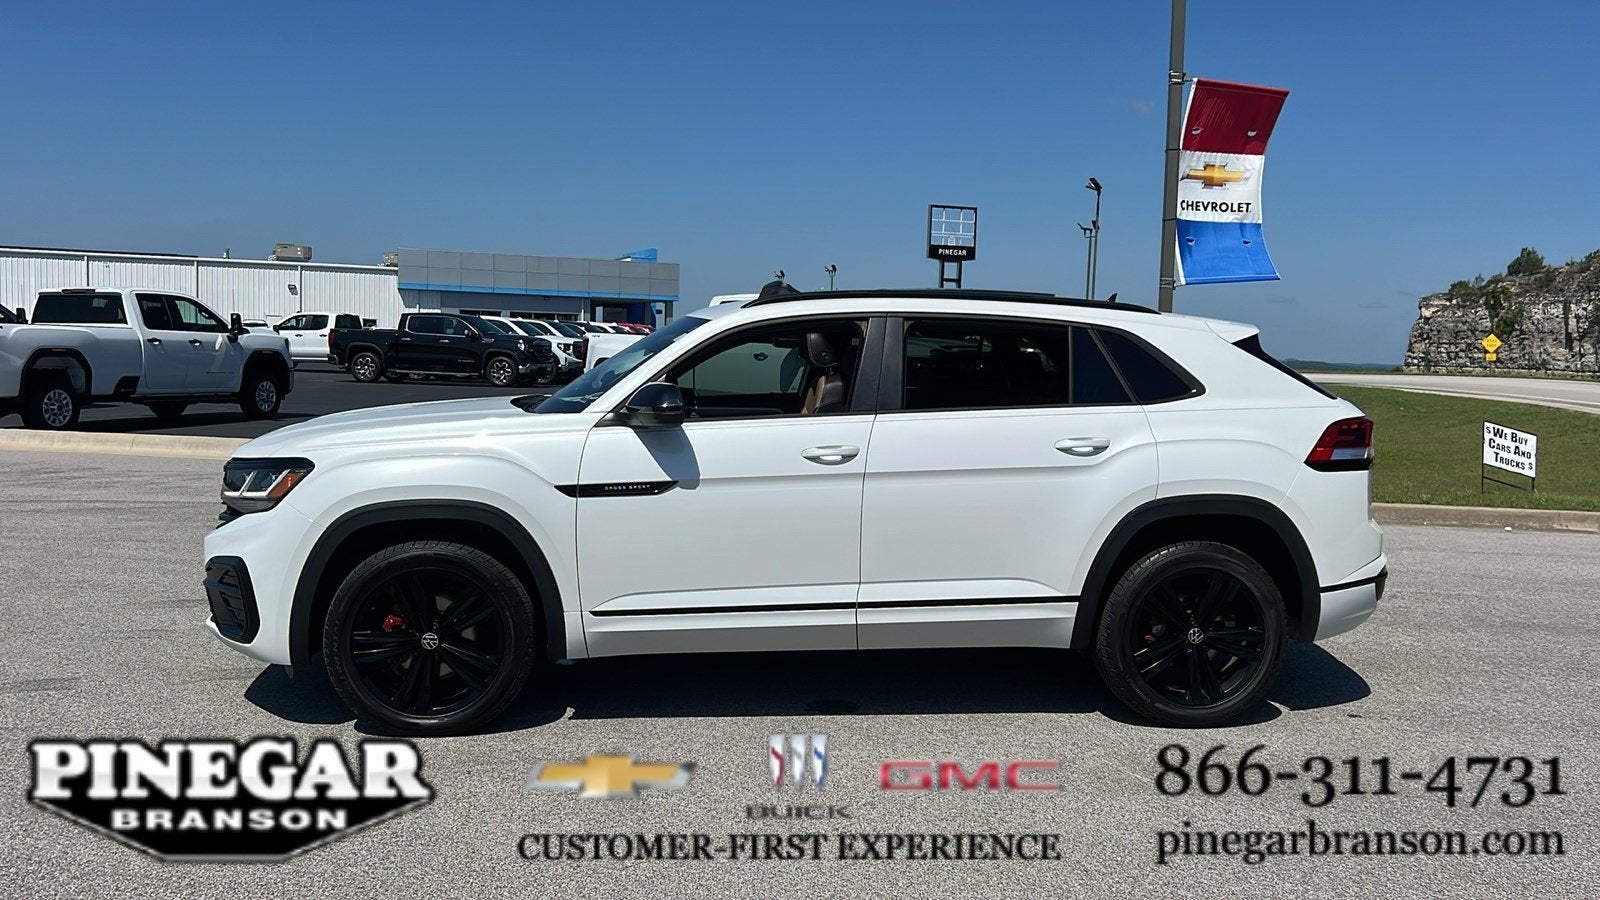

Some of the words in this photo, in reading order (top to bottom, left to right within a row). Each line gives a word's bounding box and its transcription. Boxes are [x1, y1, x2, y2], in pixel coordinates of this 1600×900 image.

[1180, 199, 1252, 213] CHEVROLET
[938, 248, 967, 256] PINEGAR
[1510, 431, 1529, 446] BUY
[1488, 437, 1512, 454] CARS
[1513, 445, 1532, 460] AND
[1493, 451, 1526, 471] TRUCKS
